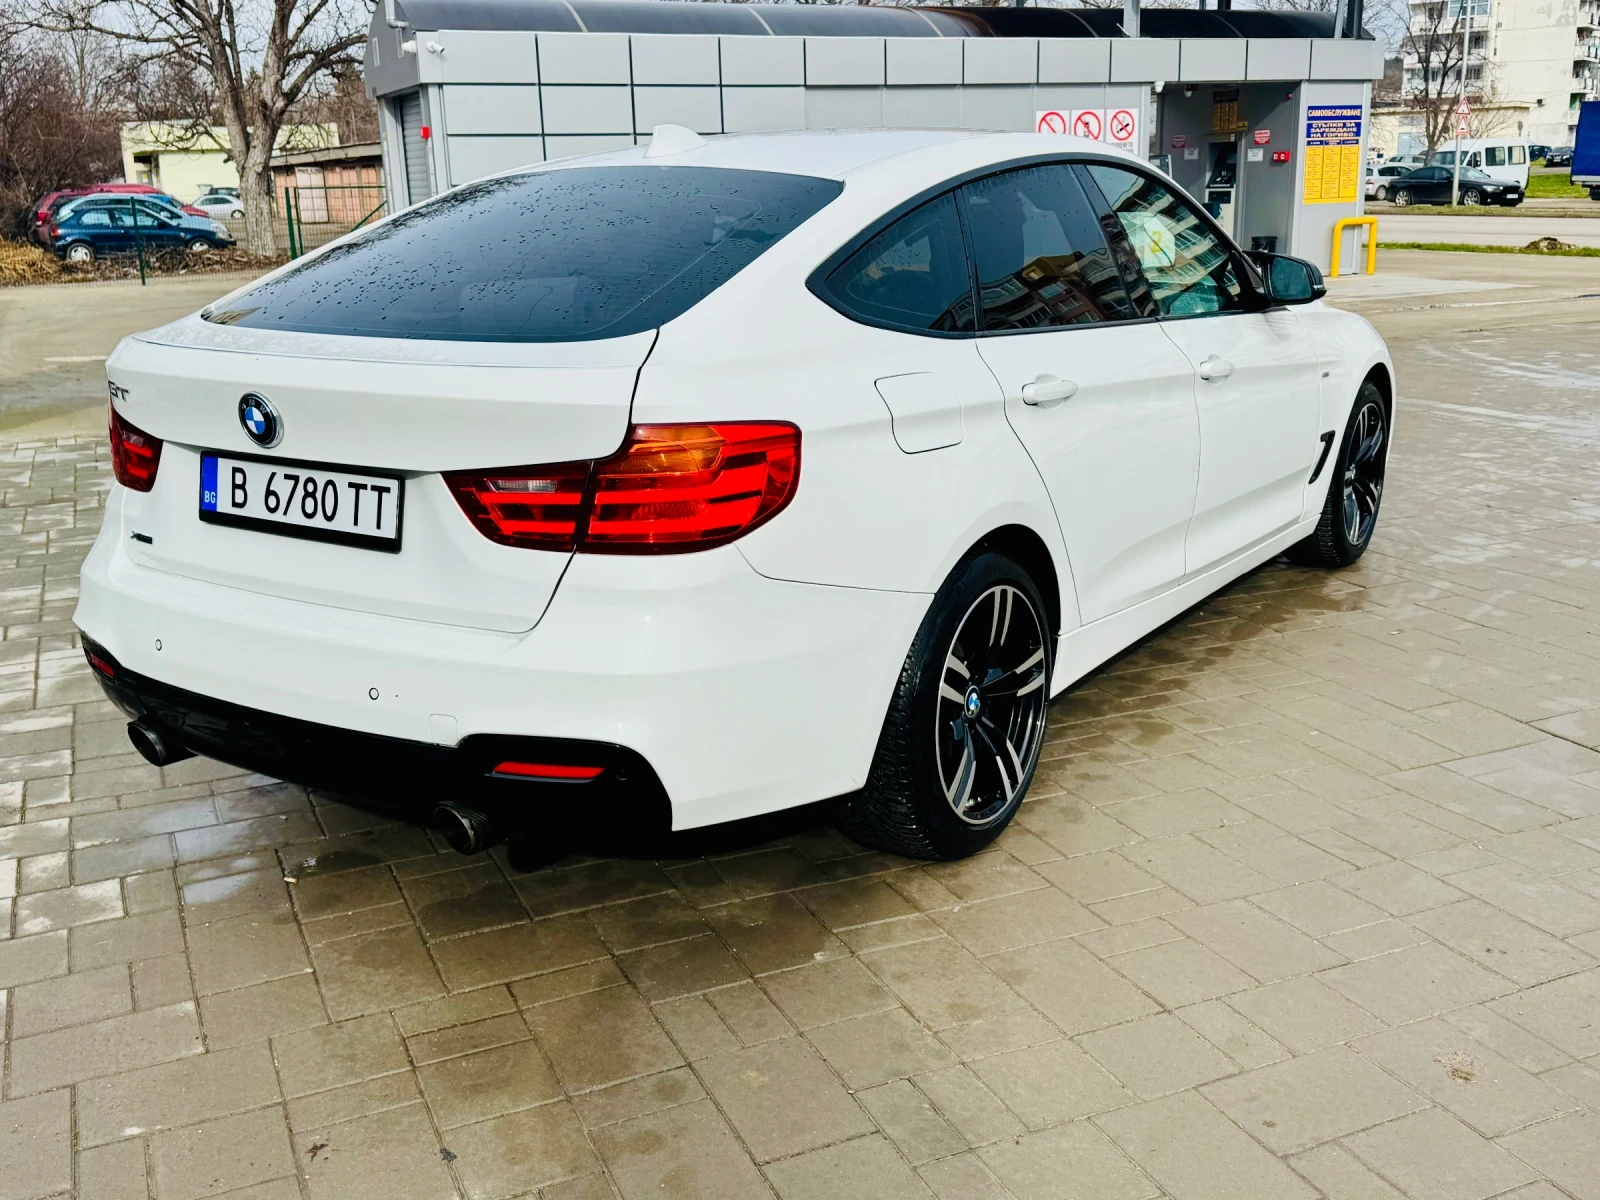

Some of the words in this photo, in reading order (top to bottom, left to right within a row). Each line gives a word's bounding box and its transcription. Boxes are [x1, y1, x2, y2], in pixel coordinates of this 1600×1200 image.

[1308, 108, 1361, 117] САМООБСЛУЖВАНЕ
[241, 398, 268, 414] BMW
[204, 490, 216, 504] BG
[231, 466, 248, 509] B
[264, 471, 339, 522] 6780
[347, 481, 391, 530] TT
